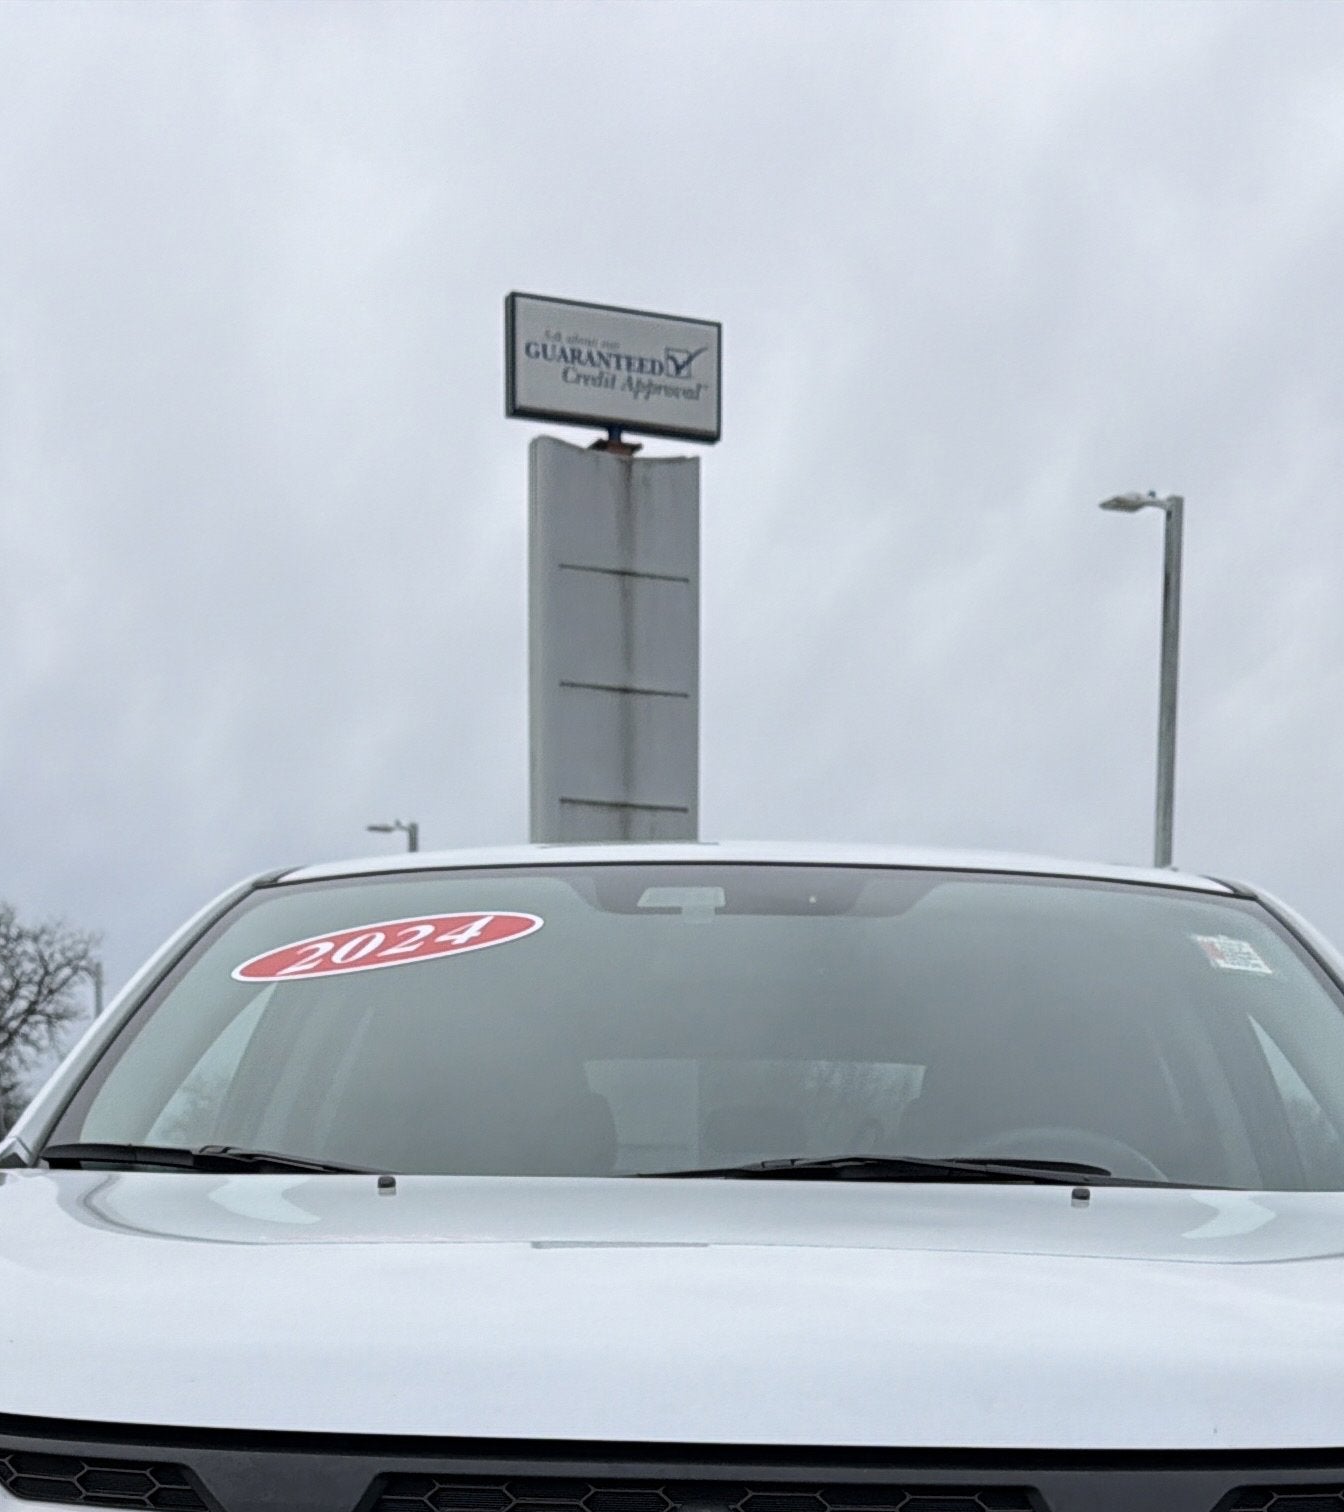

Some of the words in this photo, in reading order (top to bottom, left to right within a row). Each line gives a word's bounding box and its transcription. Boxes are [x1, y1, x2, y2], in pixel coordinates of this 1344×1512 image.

[524, 342, 664, 376] GUARANTEED
[561, 366, 616, 390] Credit
[621, 374, 703, 401] Approval
[276, 914, 495, 976] 2024
